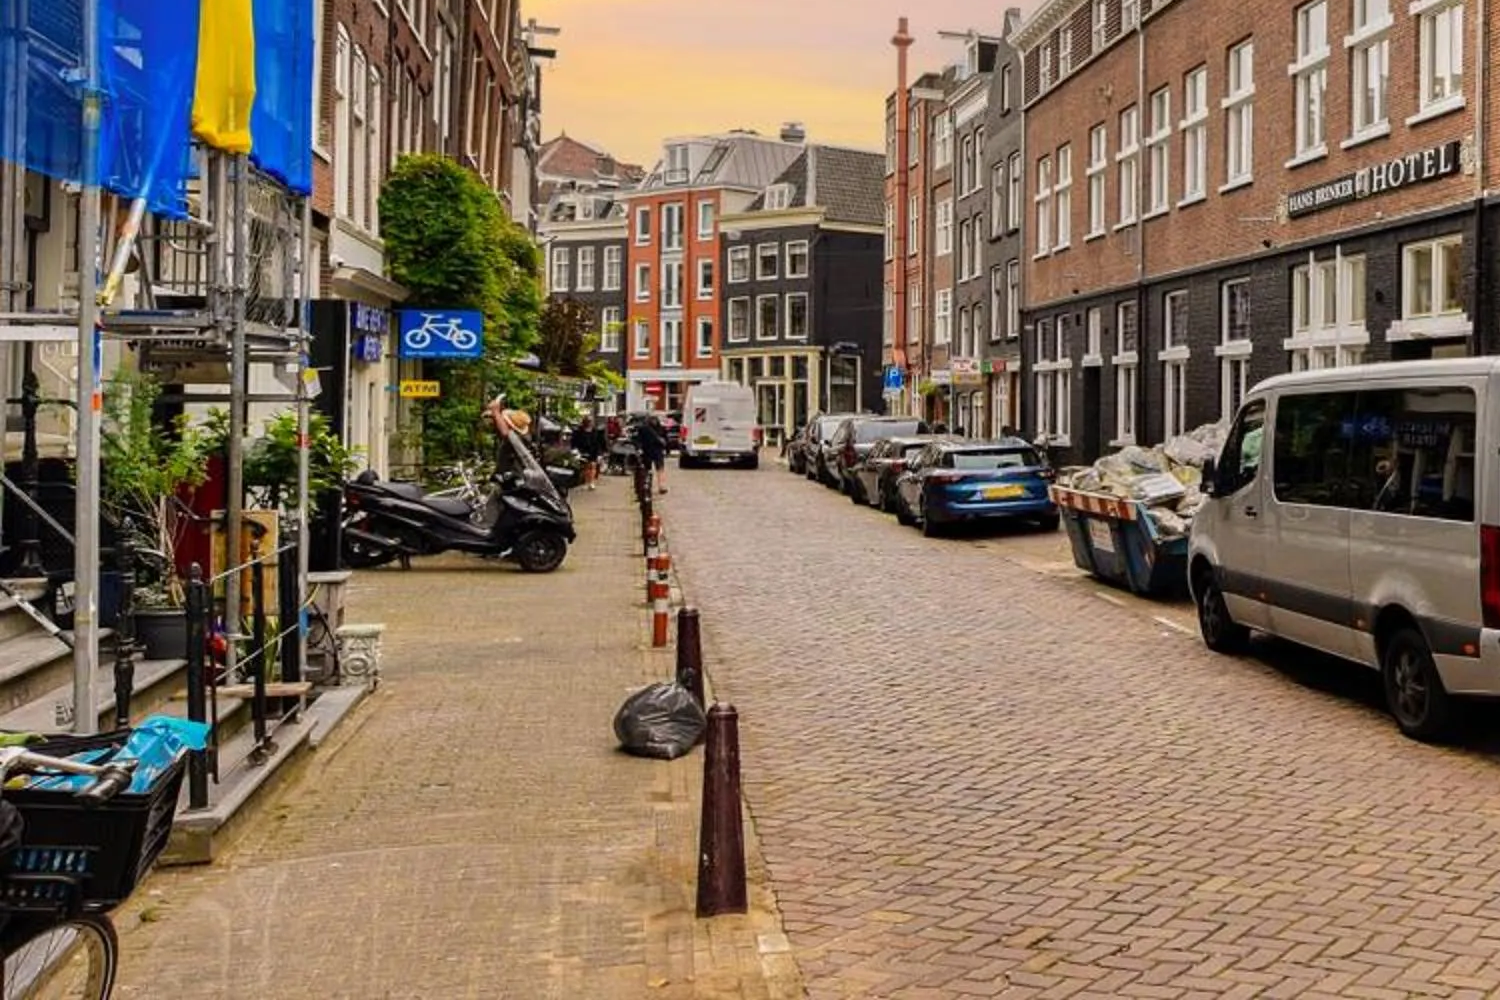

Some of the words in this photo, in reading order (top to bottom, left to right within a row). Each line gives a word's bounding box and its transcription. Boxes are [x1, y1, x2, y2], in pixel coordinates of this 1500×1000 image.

[1289, 191, 1314, 212] HANS
[1315, 179, 1354, 205] BRINKER
[1372, 146, 1452, 192] HOTEL
[402, 383, 438, 394] ATM
